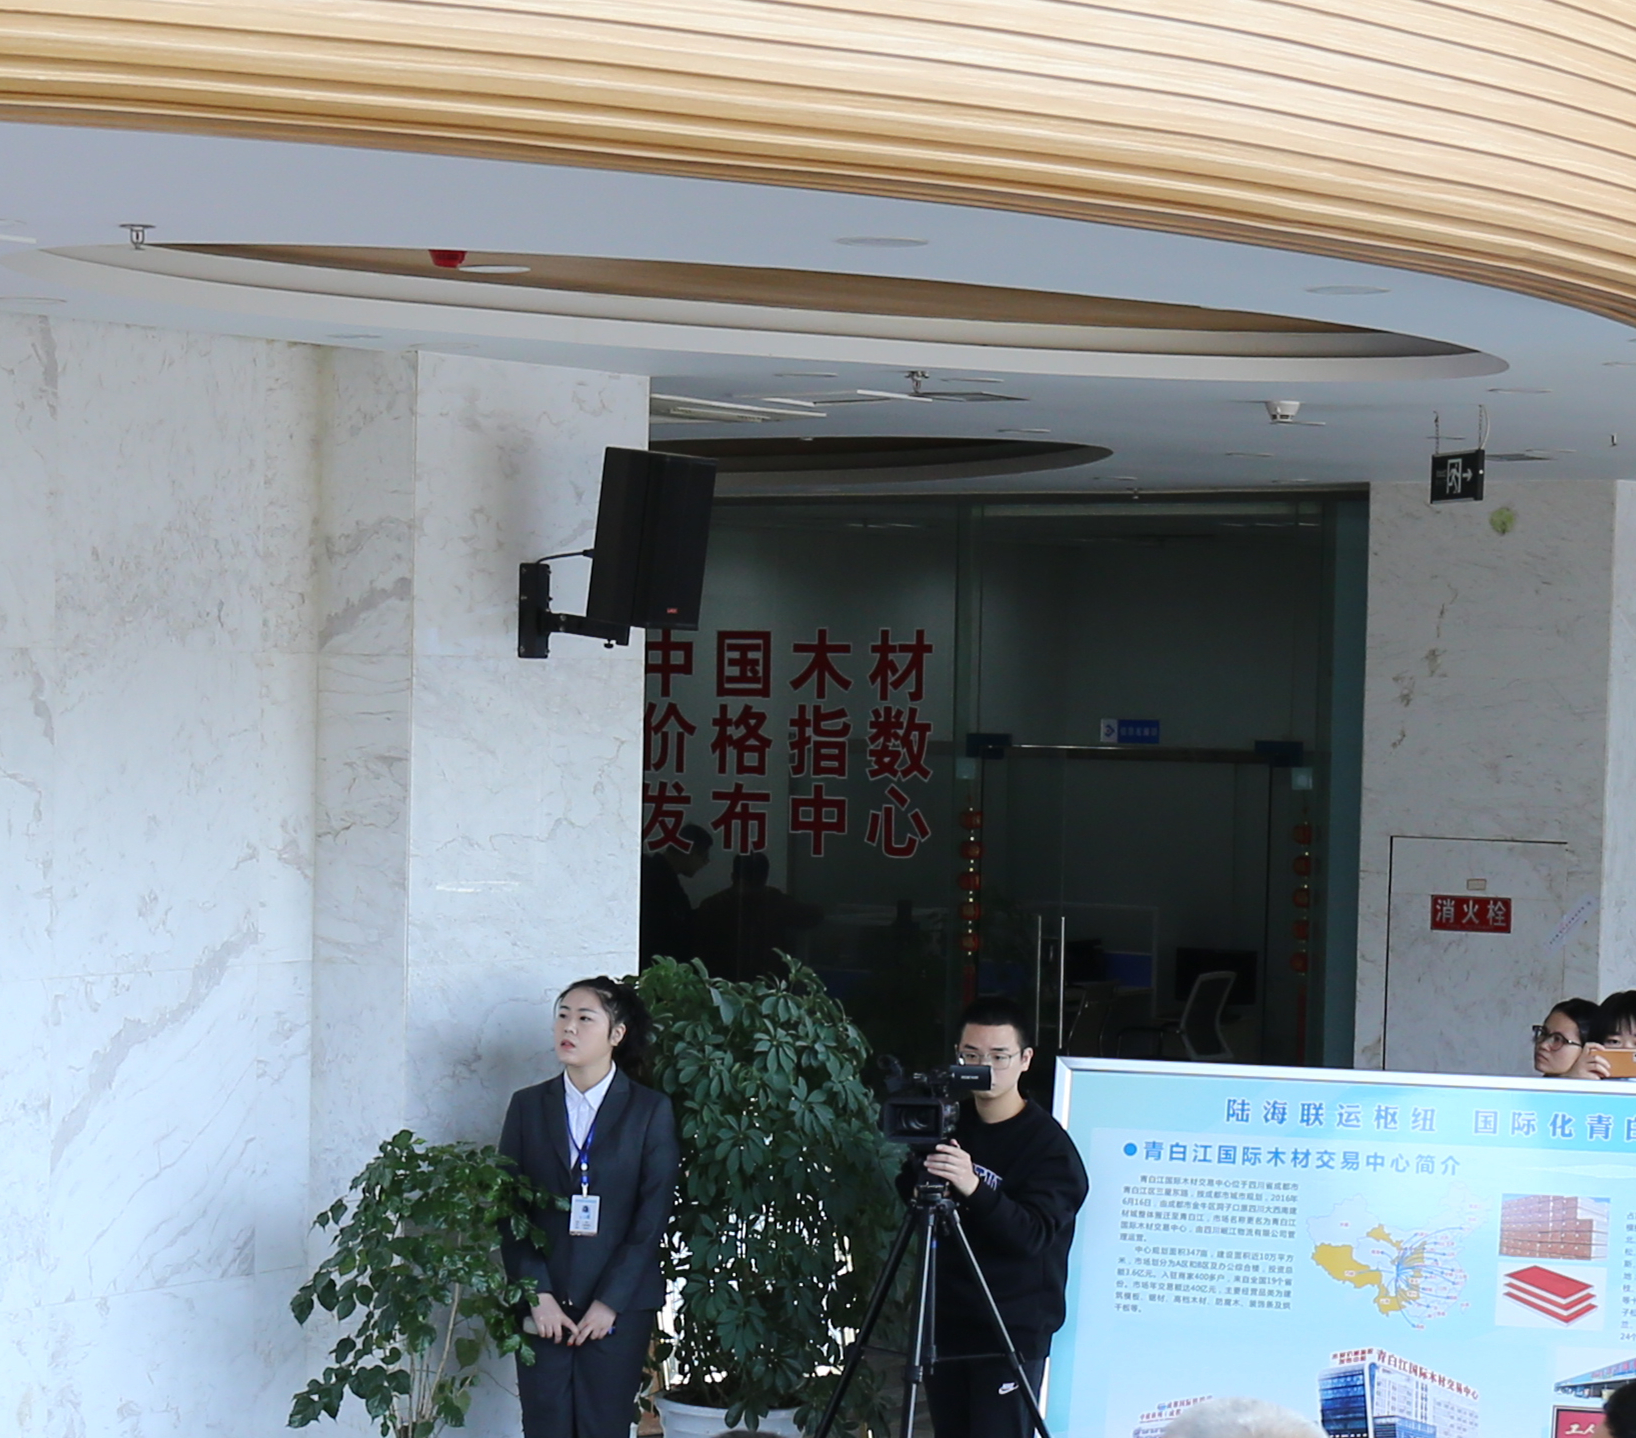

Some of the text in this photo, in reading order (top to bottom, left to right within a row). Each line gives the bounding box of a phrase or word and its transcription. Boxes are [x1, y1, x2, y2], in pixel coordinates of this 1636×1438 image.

[644, 627, 934, 702] 中国木材
[643, 702, 933, 782] 价格指数
[643, 781, 932, 858] 发布中心
[1435, 898, 1507, 927] 消火栓
[1225, 1097, 1437, 1133] 陆海联运枢纽
[1143, 1140, 1461, 1176] 青白江国际木材交易中心简介
